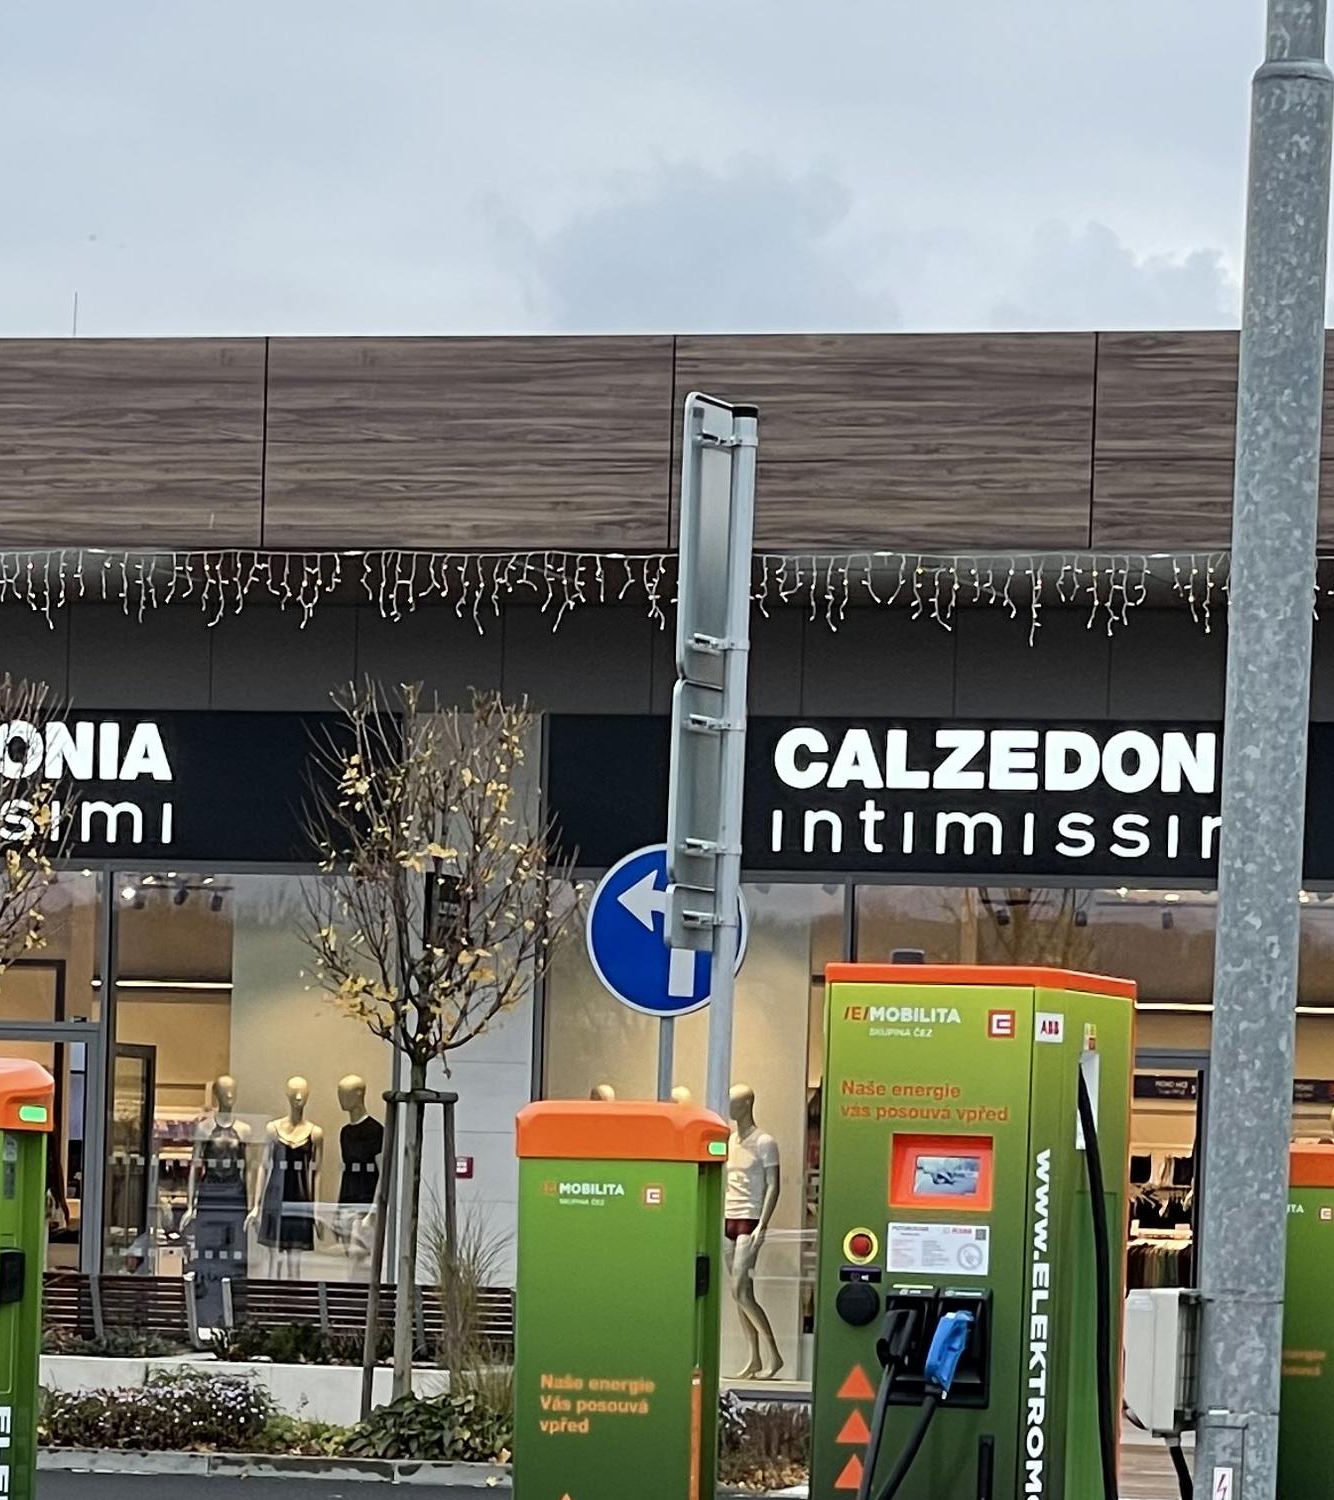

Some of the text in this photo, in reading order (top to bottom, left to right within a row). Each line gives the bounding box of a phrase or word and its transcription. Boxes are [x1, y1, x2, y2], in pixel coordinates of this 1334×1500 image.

[774, 727, 1216, 794] CALZEDON
[771, 800, 1222, 859] intimissi
[869, 1027, 932, 1038] SKUPINA ČEZ
[1041, 1020, 1059, 1035] ABB
[842, 1080, 960, 1101] Naše energie
[841, 1103, 1008, 1122] vás posouvá vpřed
[540, 1374, 655, 1395] Naše energie
[540, 1395, 648, 1414] Vás posouvá
[540, 1417, 589, 1434] vpřed
